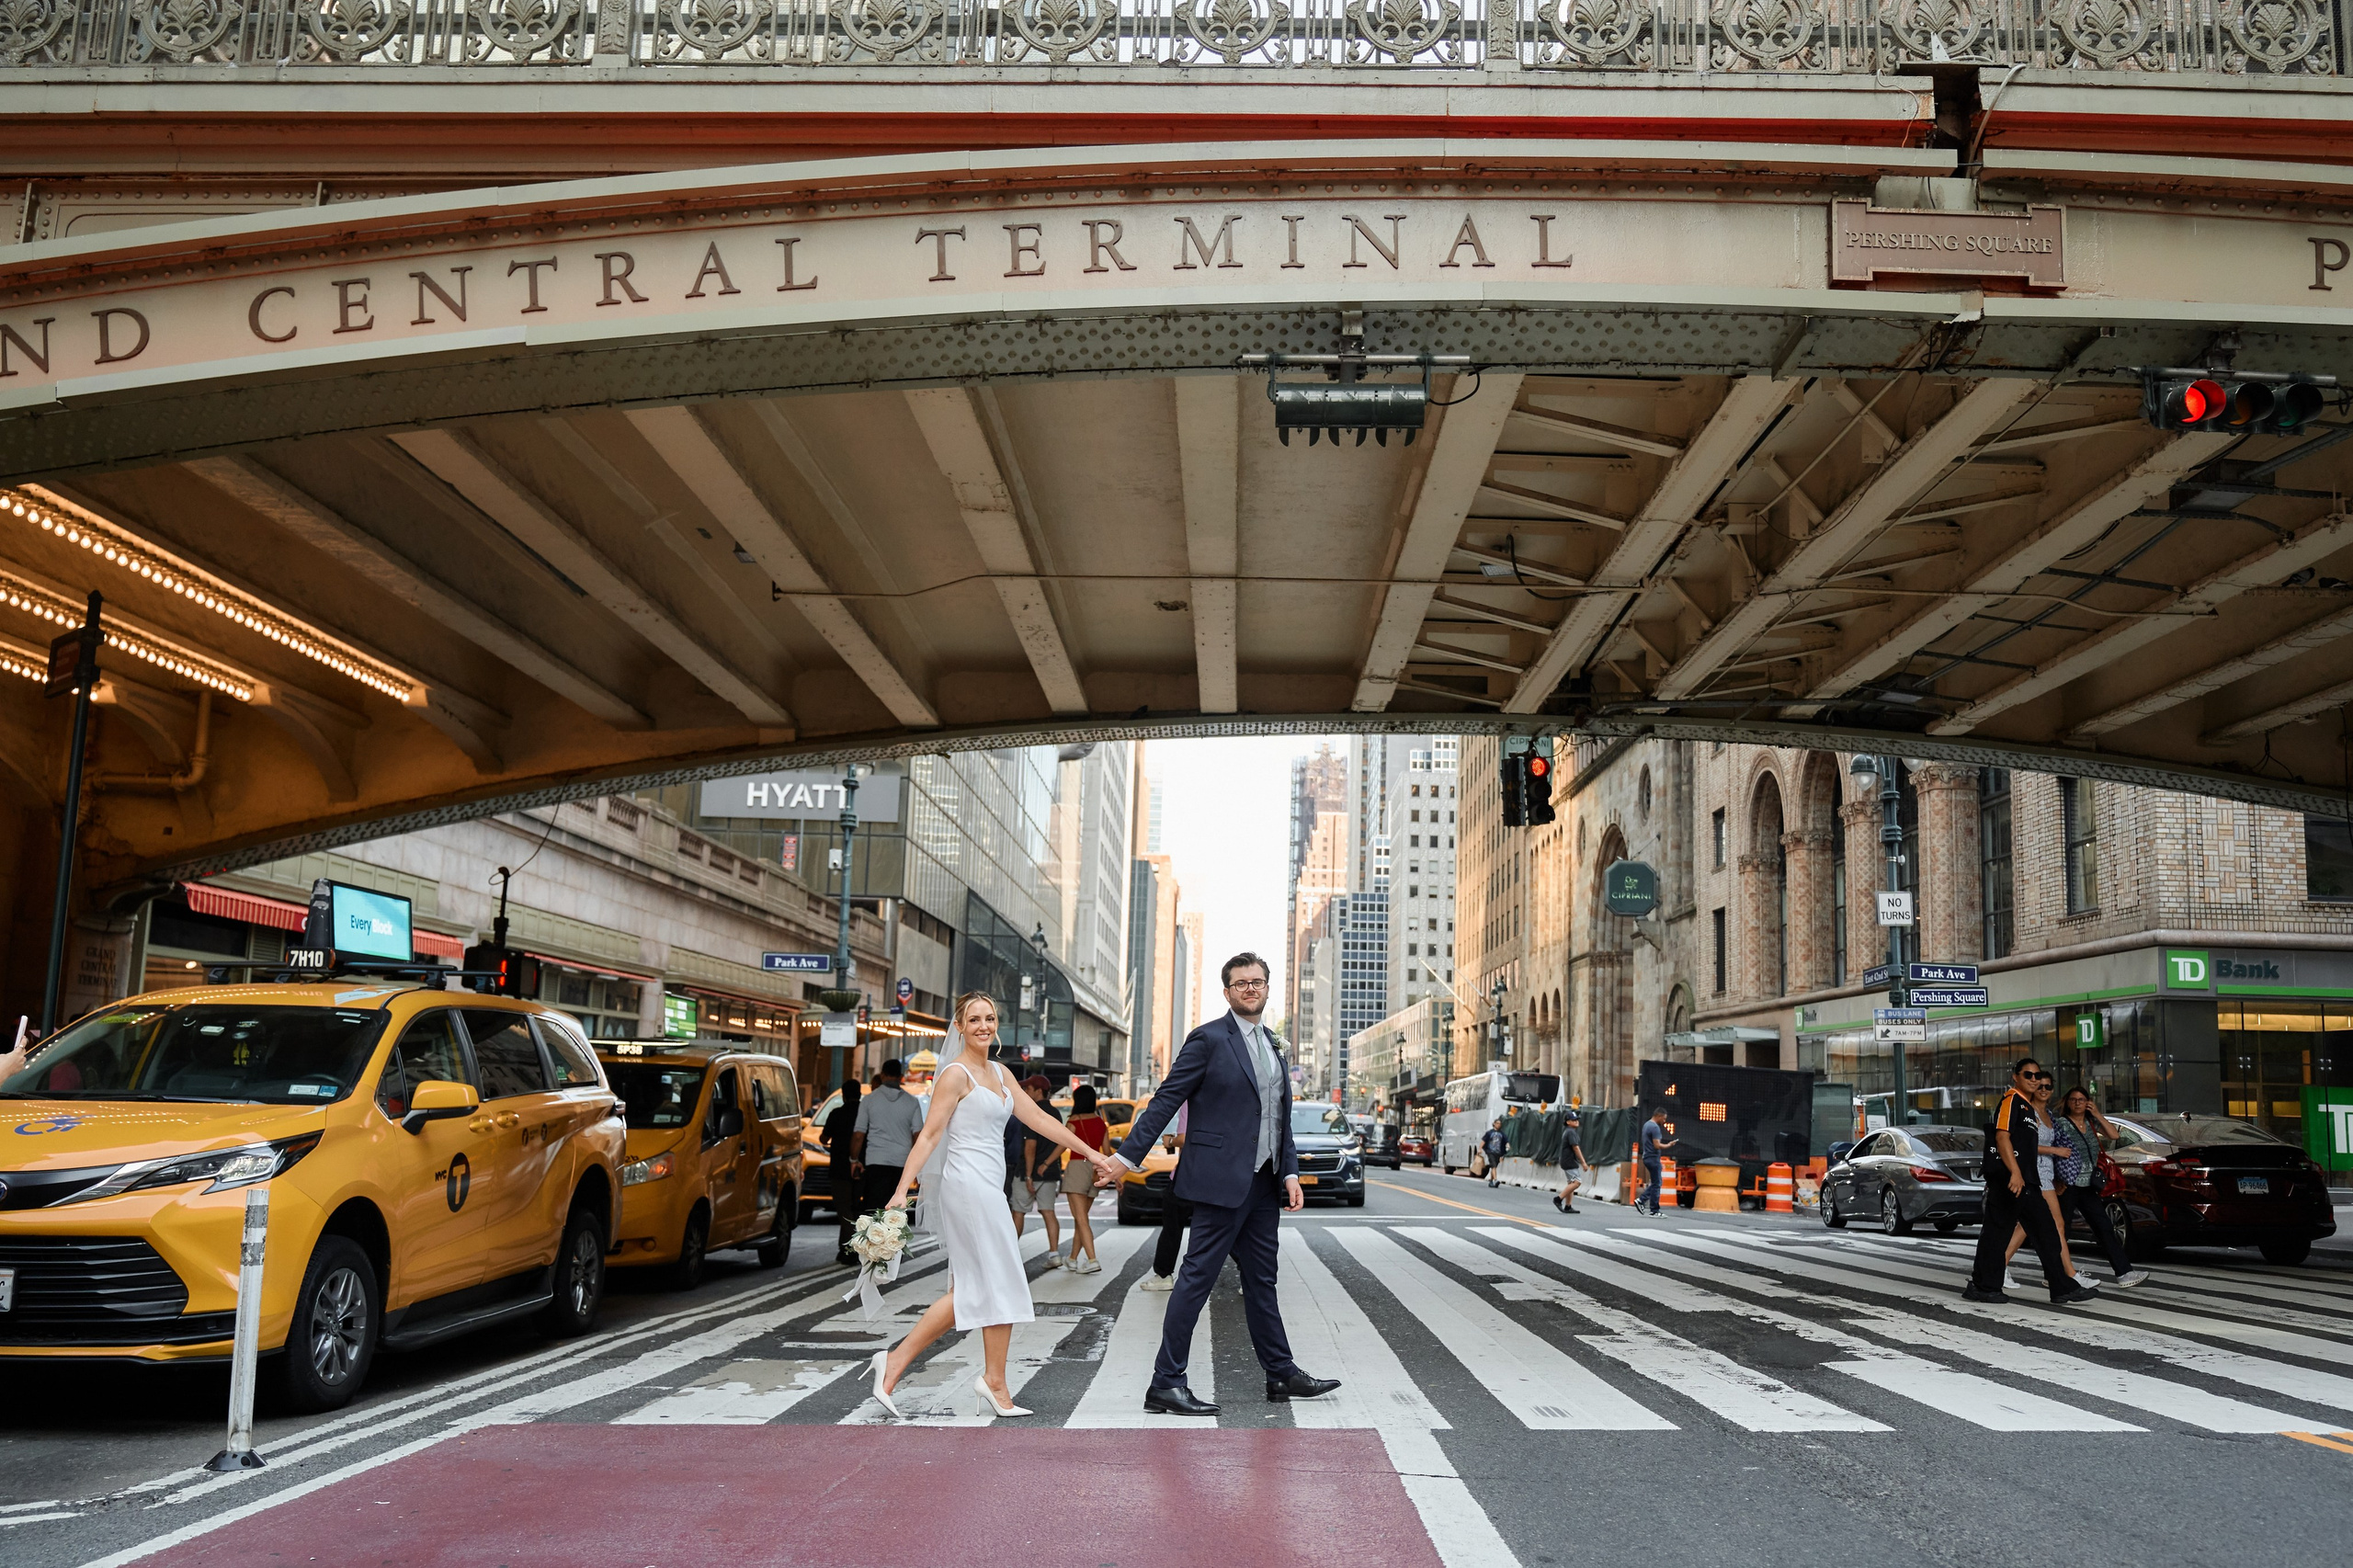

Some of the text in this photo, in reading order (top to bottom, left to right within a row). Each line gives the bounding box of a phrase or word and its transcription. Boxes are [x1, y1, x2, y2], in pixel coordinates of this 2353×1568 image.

[1847, 232, 2053, 256] PERSHING SQUARE
[248, 236, 818, 343] CENTRAL
[915, 213, 1573, 281] TERMINAL
[746, 781, 847, 809] HYATT
[1611, 892, 1652, 900] CIPRIANI
[1887, 898, 1902, 907] NO
[1881, 911, 1911, 920] TURNS
[290, 949, 324, 967] 7H10
[774, 957, 819, 969] Park Ave
[1921, 968, 1966, 980] Park Ave
[2171, 957, 2279, 982] TD Bank
[1865, 974, 1874, 983] East
[1913, 992, 1985, 1005] Pershing Square
[2078, 1018, 2095, 1043] TD
[2318, 1104, 2353, 1154] T
[435, 1169, 448, 1182] NYC
